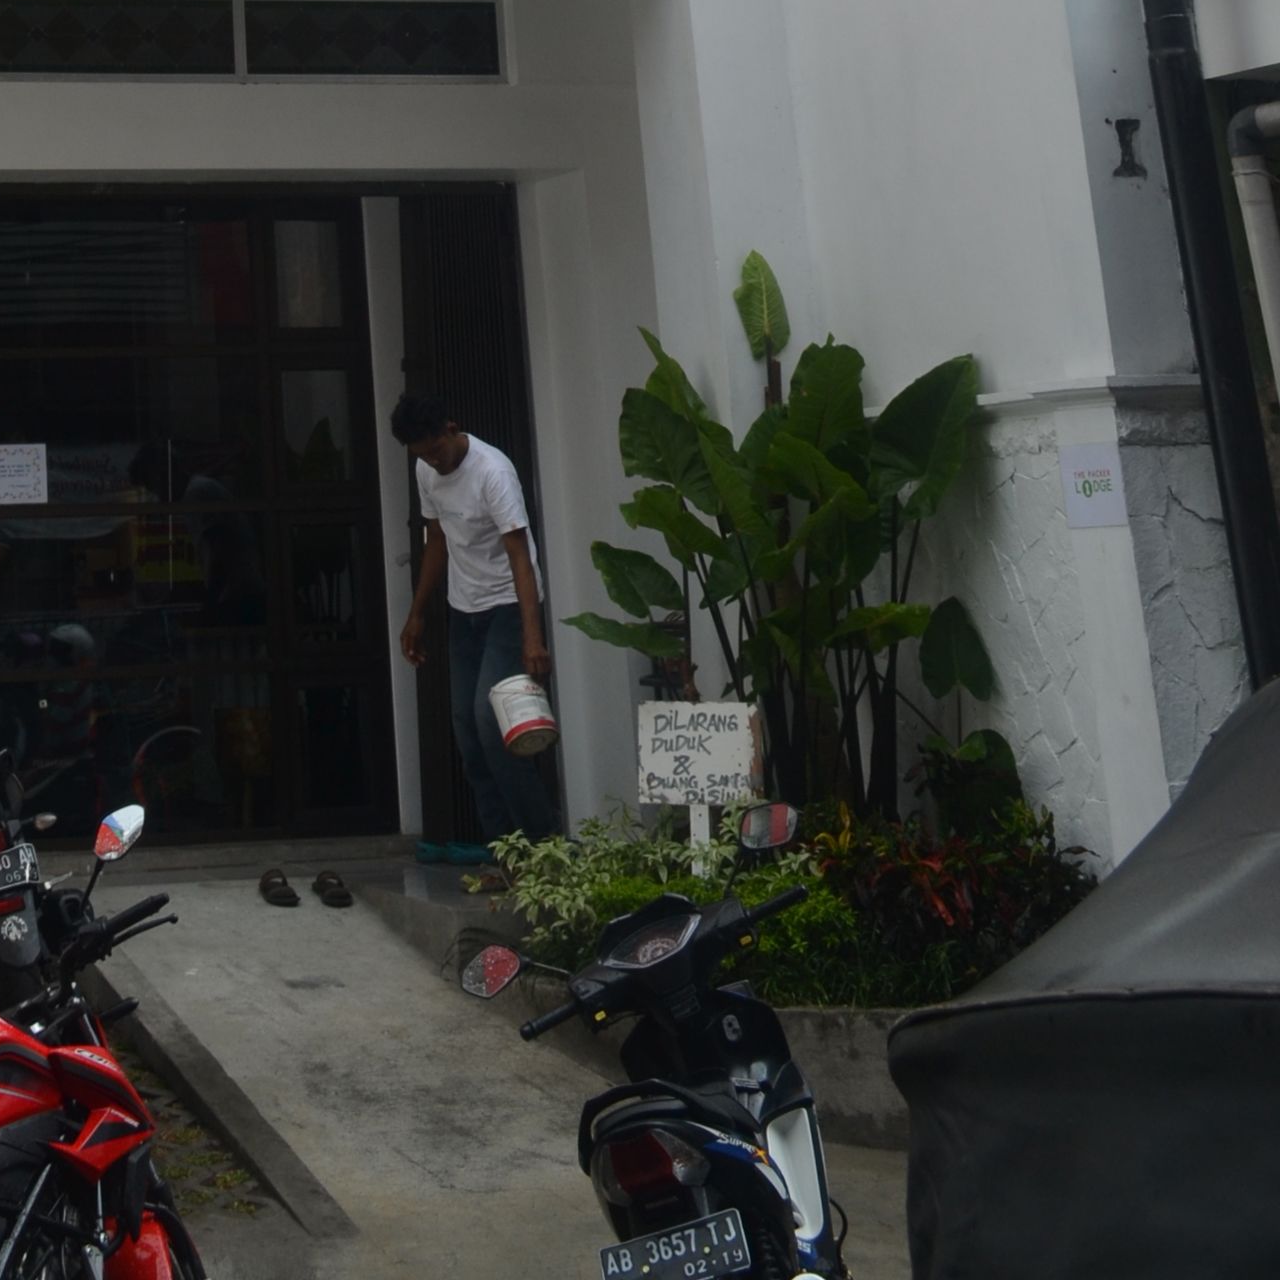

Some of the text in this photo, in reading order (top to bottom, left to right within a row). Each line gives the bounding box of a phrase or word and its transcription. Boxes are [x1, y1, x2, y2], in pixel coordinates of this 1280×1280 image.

[1075, 479, 1112, 497] LODGE
[673, 755, 695, 776] &
[607, 1216, 737, 1276] AB 3657 TJ
